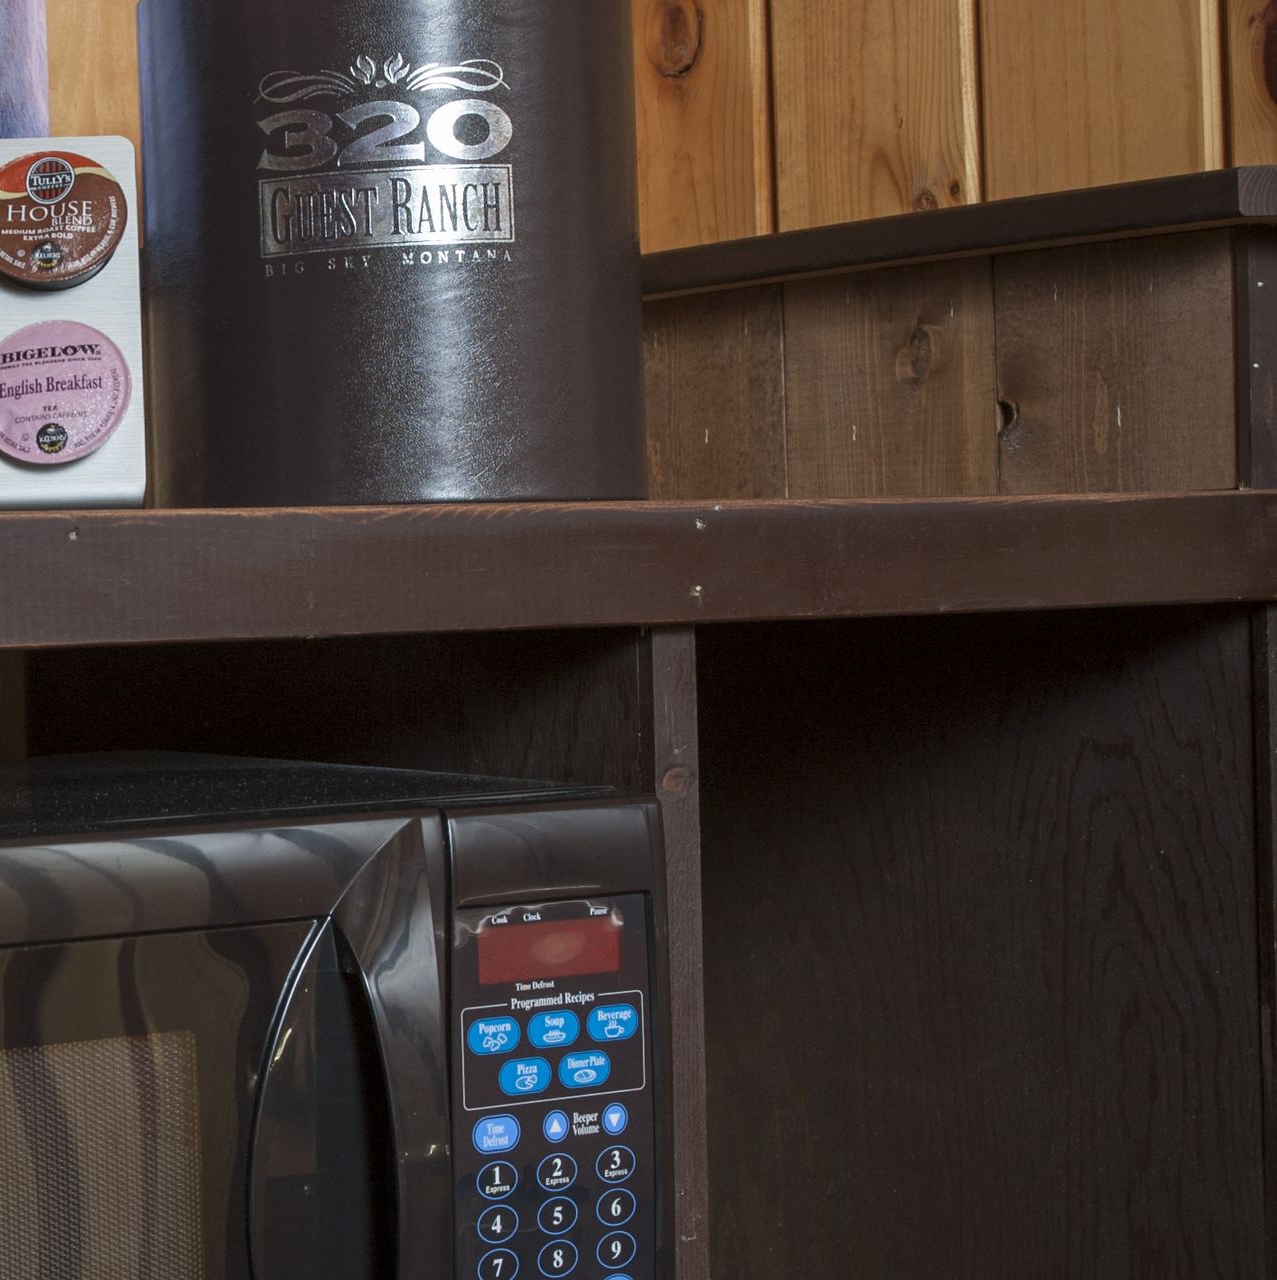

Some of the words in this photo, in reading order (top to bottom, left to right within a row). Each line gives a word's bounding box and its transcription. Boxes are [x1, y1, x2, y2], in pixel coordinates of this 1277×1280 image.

[256, 98, 513, 170] 320
[30, 174, 71, 186] TULLY'S
[7, 200, 93, 222] HOUSE
[272, 186, 380, 245] GUEST
[389, 177, 503, 236] RANCH
[52, 215, 93, 226] BLEND
[37, 226, 64, 234] ROAST
[65, 225, 96, 233] COFFEE
[51, 232, 74, 240] BOLD
[265, 261, 305, 277] BIG
[328, 255, 371, 270] SKY
[401, 249, 512, 265] MONTANA
[0, 344, 99, 365] BIGELOW
[46, 374, 103, 393] Breakfast
[14, 414, 52, 424] CONTAINS
[491, 915, 508, 925] Cook
[523, 912, 542, 922] Clock
[515, 982, 532, 992] Time
[532, 980, 555, 990] Defrost
[510, 993, 563, 1011] Programmed
[564, 991, 595, 1005] Recipes
[597, 1009, 632, 1021] Beverage
[478, 1022, 512, 1036] Popcorn
[544, 1016, 565, 1029] Soup
[567, 1057, 589, 1069] Dinner
[589, 1055, 606, 1067] Plate
[516, 1063, 538, 1075] Pizza
[573, 1112, 599, 1125] Beeper
[486, 1123, 505, 1134] Time
[572, 1123, 600, 1136] Volume
[482, 1135, 509, 1148] Defrost
[610, 1150, 621, 1169] 3
[551, 1158, 563, 1177] 2
[604, 1167, 629, 1179] Express
[492, 1166, 502, 1185] 1
[545, 1176, 570, 1187] Express
[485, 1184, 511, 1195] Express
[611, 1197, 622, 1217] 6
[552, 1206, 563, 1226] 5
[491, 1214, 503, 1234] 4
[611, 1240, 622, 1260] 9
[552, 1249, 564, 1269] 8
[492, 1258, 504, 1278] 7
